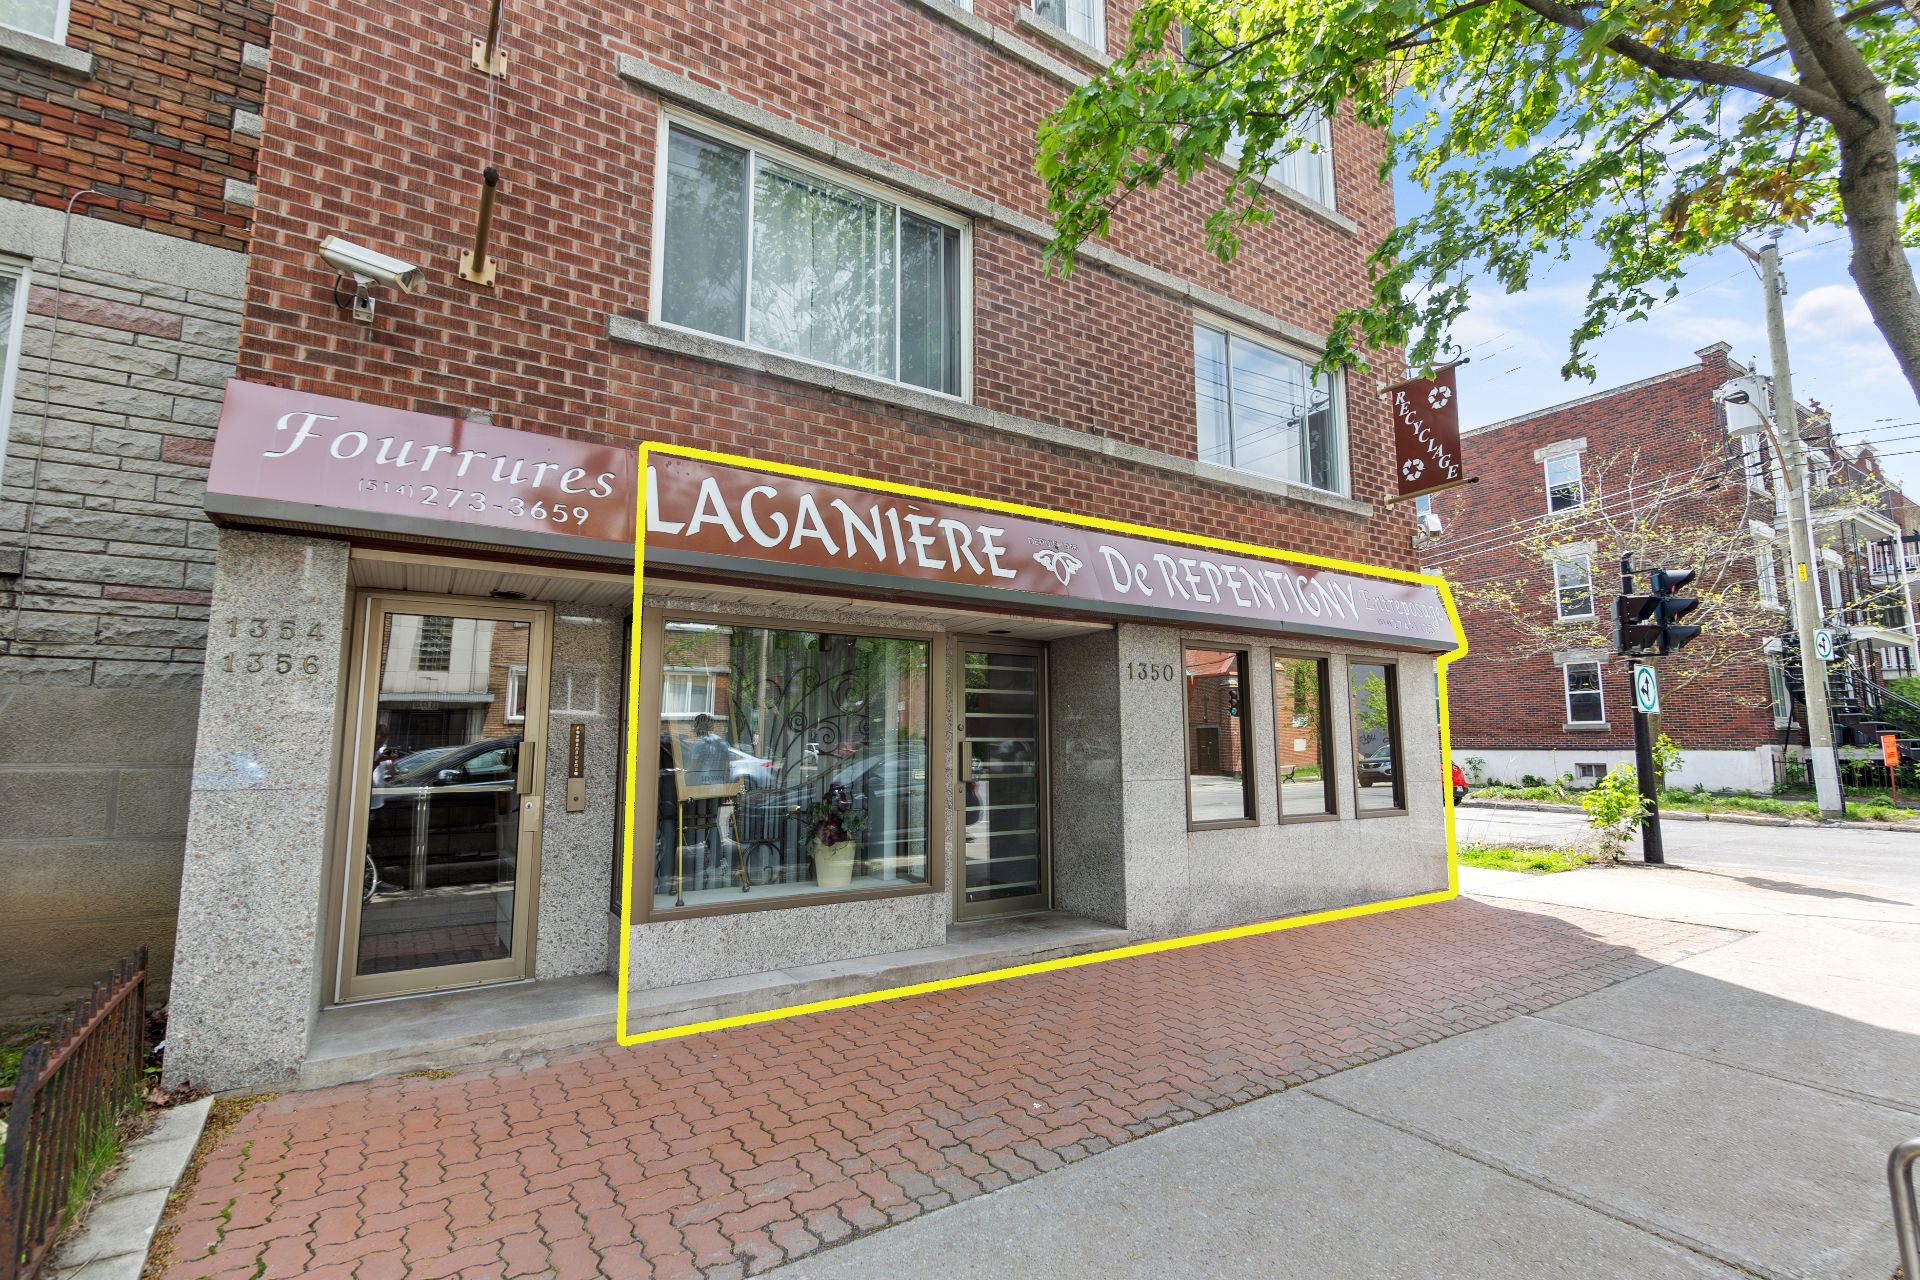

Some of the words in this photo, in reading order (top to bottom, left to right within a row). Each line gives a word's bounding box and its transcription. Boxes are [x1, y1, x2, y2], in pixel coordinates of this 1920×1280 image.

[263, 411, 616, 499] Fourrures
[1395, 391, 1459, 480] RECYCLAGE
[420, 484, 590, 526] 273-3659
[646, 465, 1017, 579] LAGANIÈRE
[1099, 545, 1153, 597] De
[1153, 553, 1360, 622] REPENTIGNY
[226, 616, 324, 641] 1354
[1359, 589, 1443, 629] Entreposage
[222, 651, 320, 675] 1356
[1128, 662, 1174, 681] 1350
